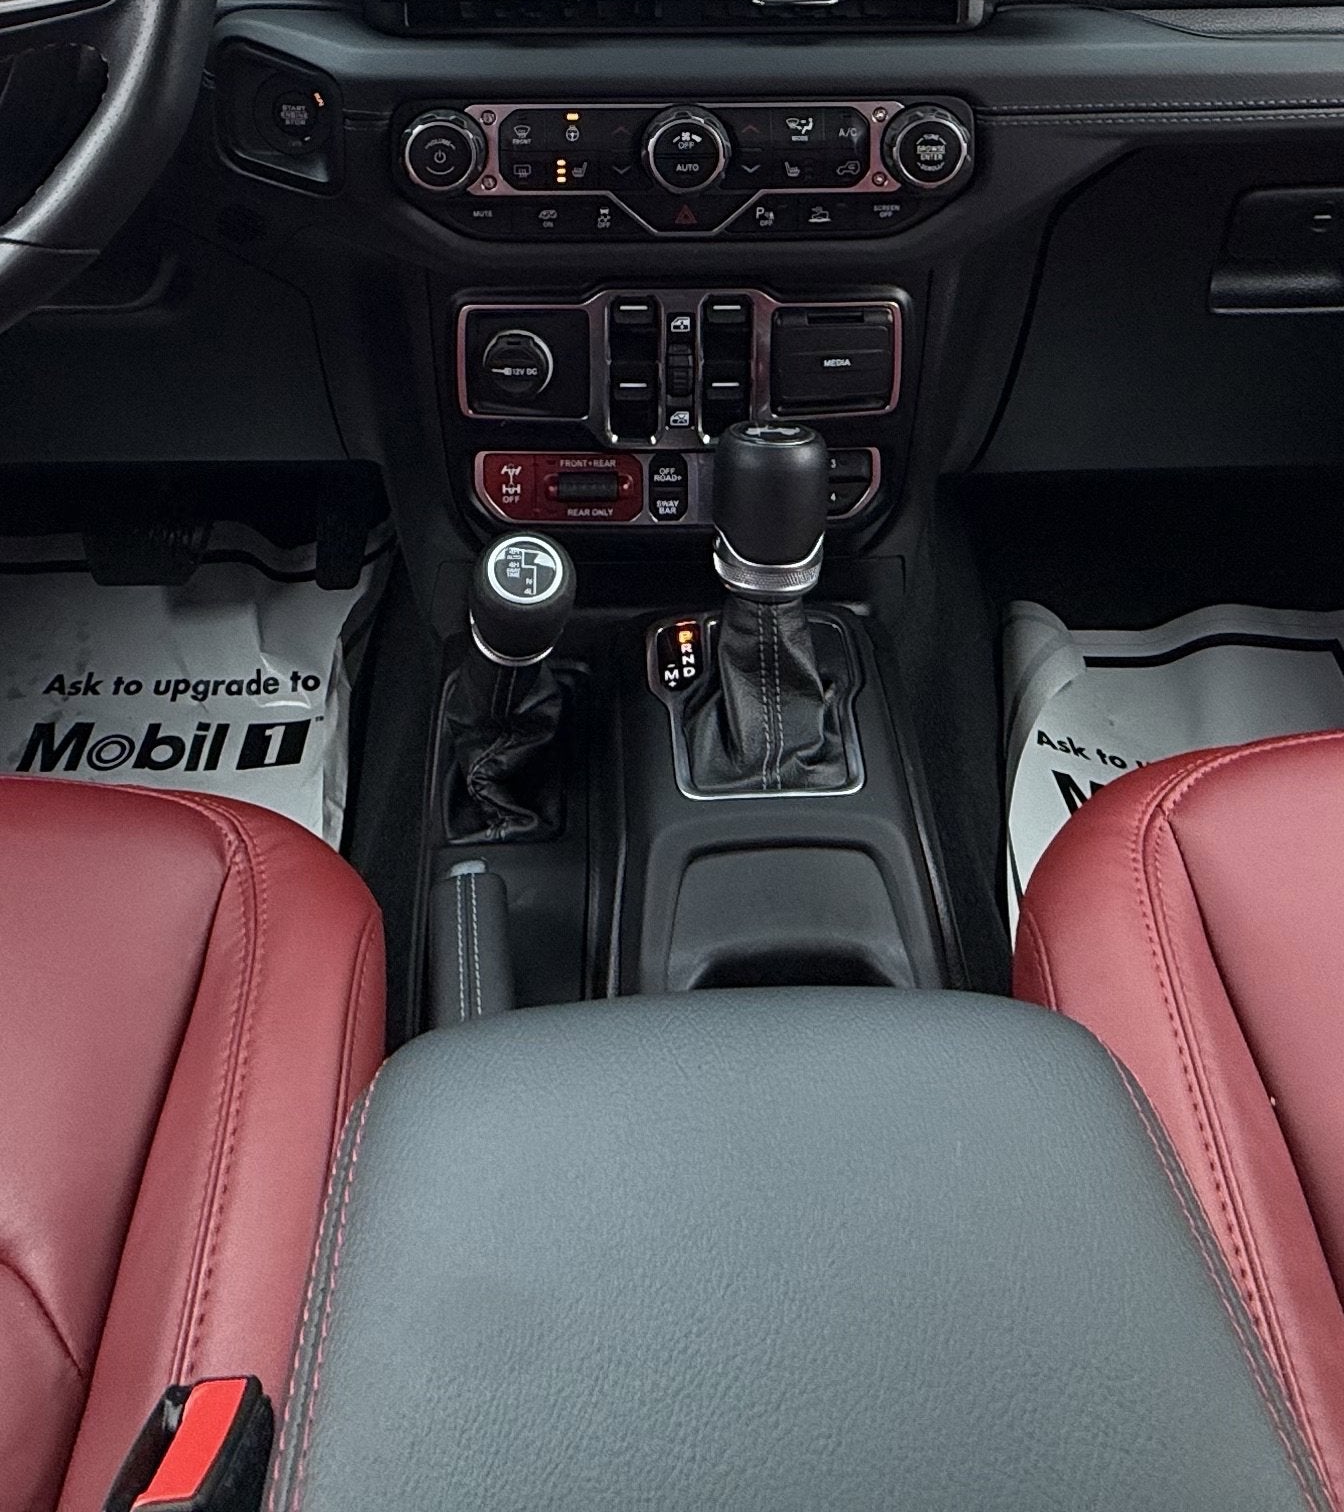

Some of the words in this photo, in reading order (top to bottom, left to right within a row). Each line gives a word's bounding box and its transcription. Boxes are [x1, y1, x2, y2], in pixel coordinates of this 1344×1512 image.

[838, 127, 858, 137] A/C
[677, 141, 695, 150] OFF
[920, 153, 943, 161] ENTER
[675, 163, 700, 172] AUTO
[873, 204, 901, 212] SCREEN
[472, 210, 493, 218] MUTE
[823, 358, 851, 368] MEDIA
[512, 367, 526, 376] 12V
[526, 367, 538, 376] DC
[830, 458, 837, 469] 3
[658, 467, 676, 475] OFF
[501, 495, 521, 504] OFF
[830, 492, 837, 503] 4
[656, 500, 680, 508] SWAY
[567, 508, 589, 517] REAR
[590, 508, 614, 517] ONLY
[658, 507, 677, 515] BAR
[679, 630, 692, 643] P
[681, 643, 692, 653] R
[681, 655, 695, 665] N
[664, 669, 679, 680] M
[683, 667, 695, 677] D
[43, 672, 101, 697] Ask
[113, 675, 143, 697] to
[153, 669, 280, 702] upgrade
[290, 670, 321, 692] to
[15, 721, 231, 773] Mobil
[1036, 729, 1092, 762] Ask
[1096, 747, 1128, 770] to
